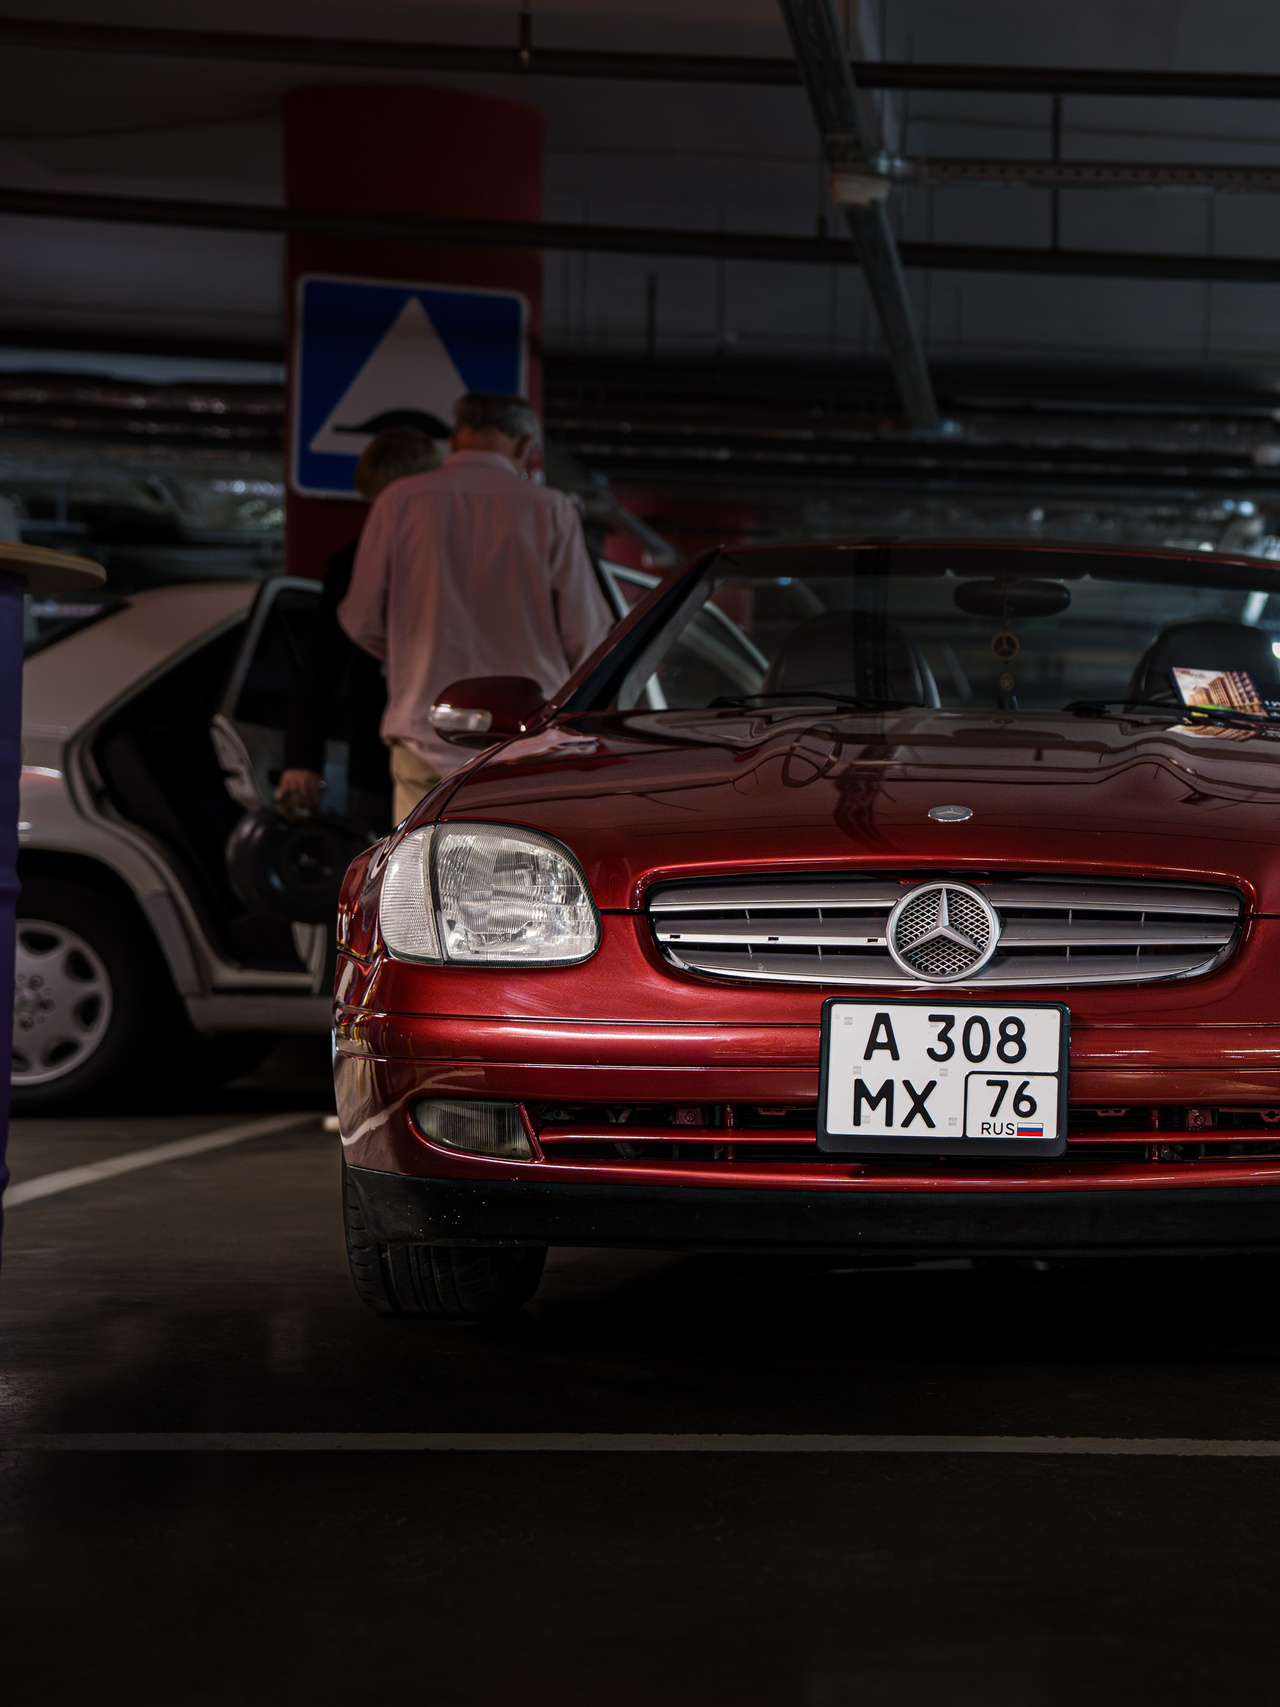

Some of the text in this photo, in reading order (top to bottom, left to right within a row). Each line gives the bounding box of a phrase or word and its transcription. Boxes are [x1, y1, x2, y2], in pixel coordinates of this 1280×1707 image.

[863, 1012, 1027, 1064] A 308
[853, 1078, 938, 1128] MX
[986, 1079, 1038, 1118] 76
[981, 1122, 1015, 1136] RUS
